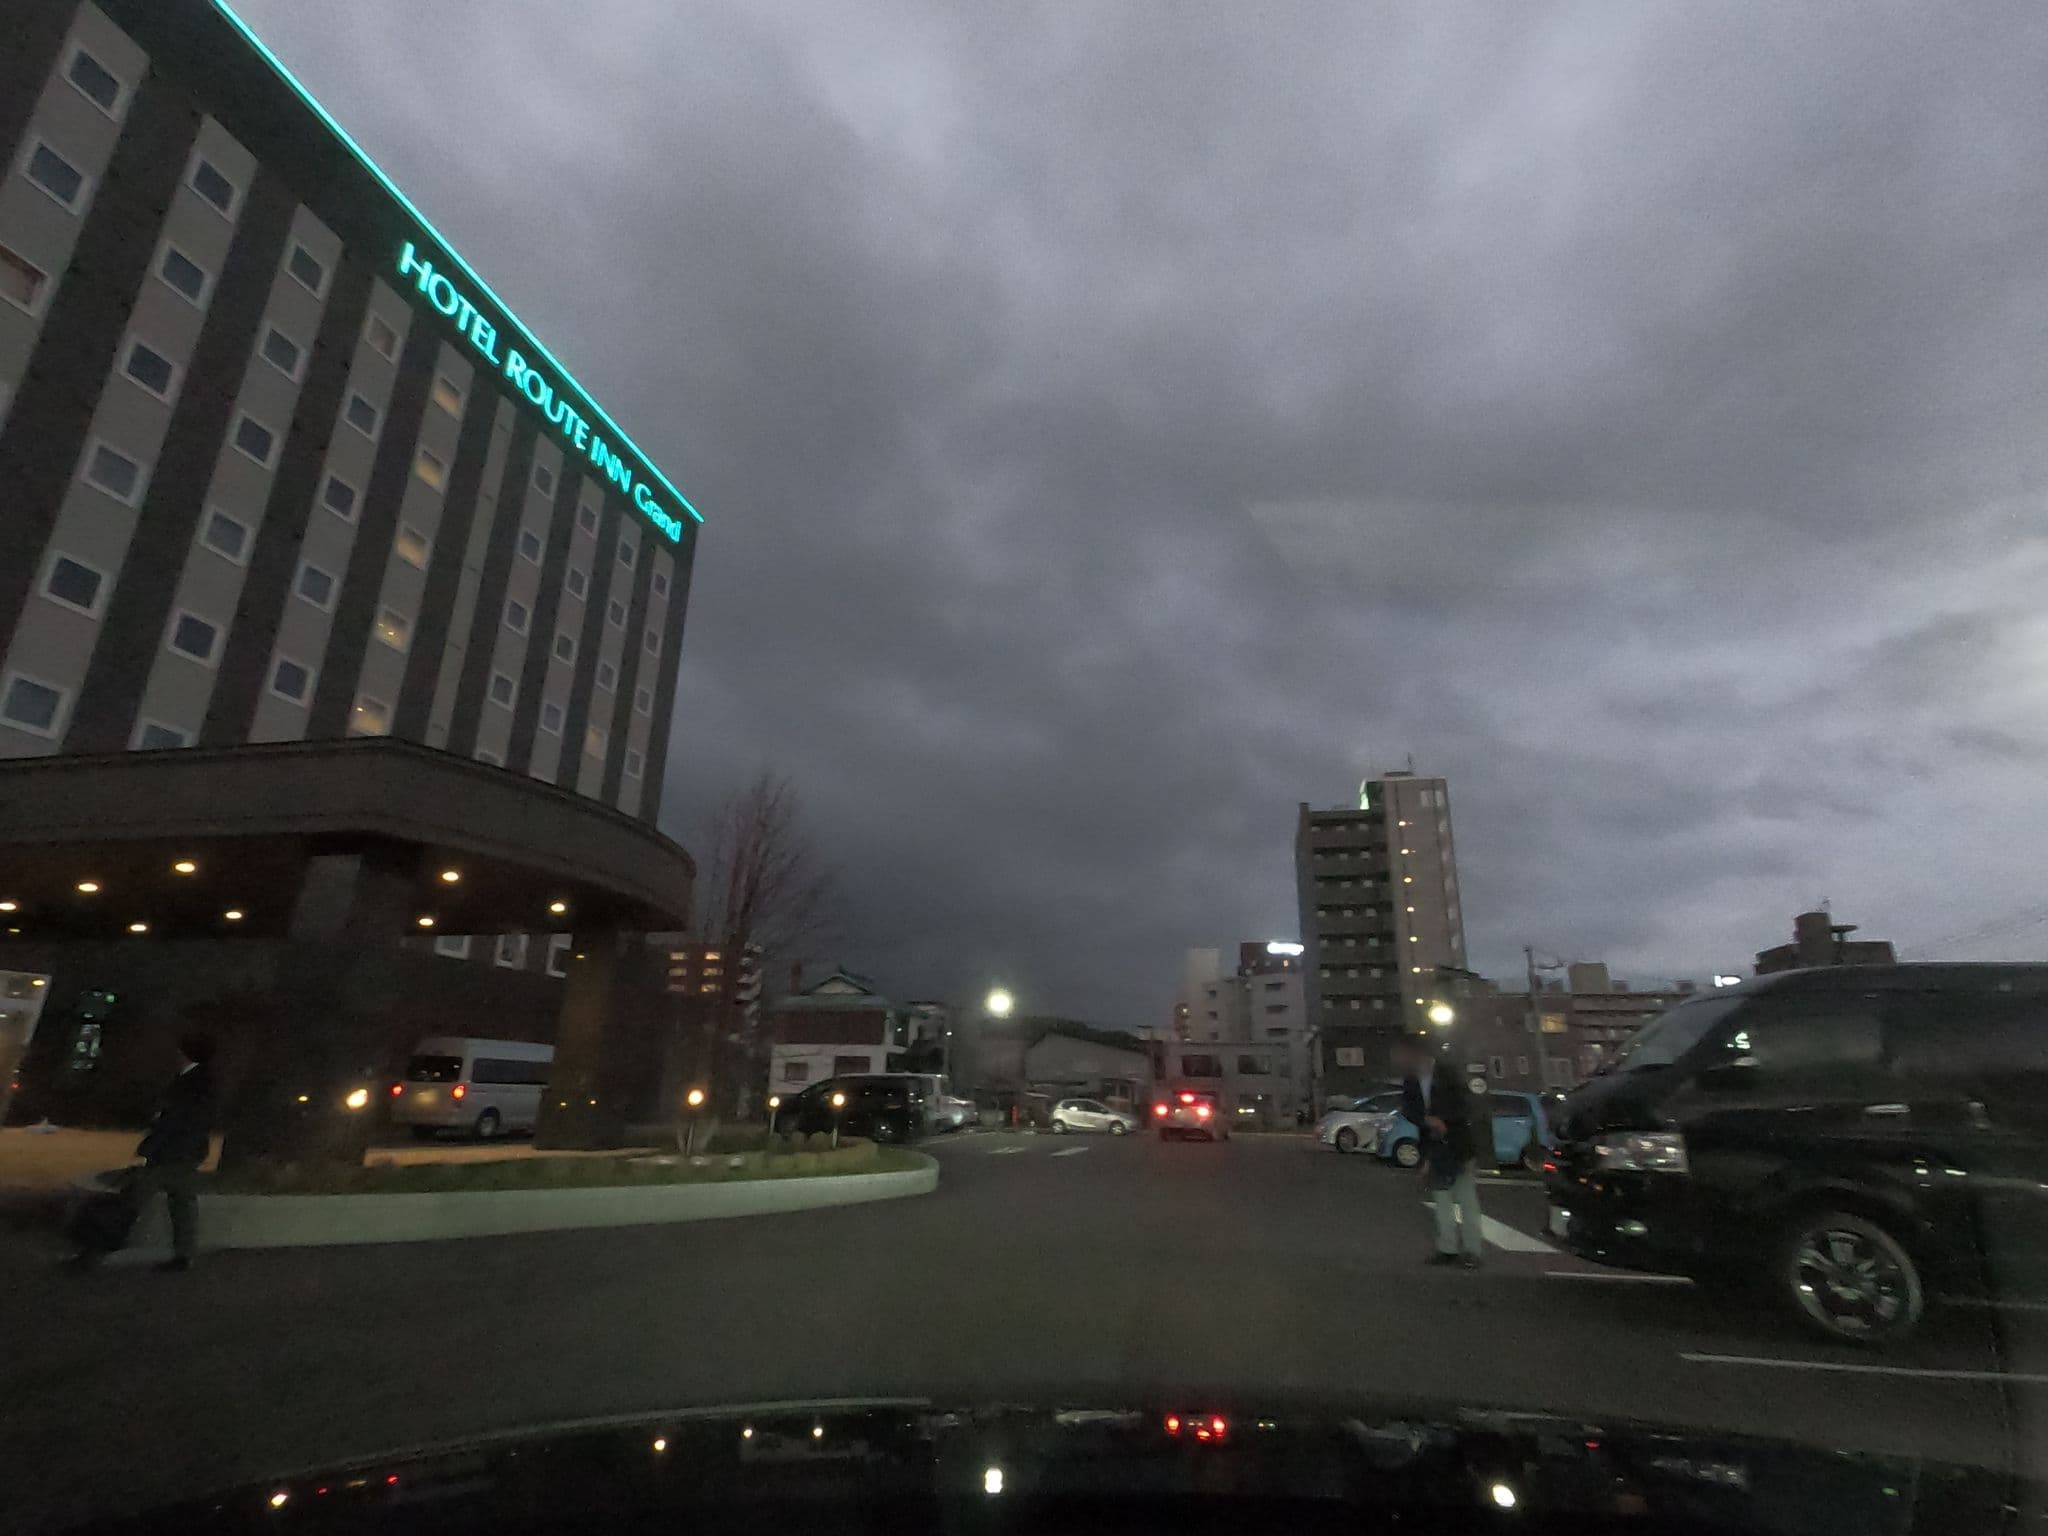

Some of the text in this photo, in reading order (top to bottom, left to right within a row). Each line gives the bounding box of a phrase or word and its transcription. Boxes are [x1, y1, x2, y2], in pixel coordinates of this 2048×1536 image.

[399, 242, 683, 543] HOTEL ROUTE INN Grand
